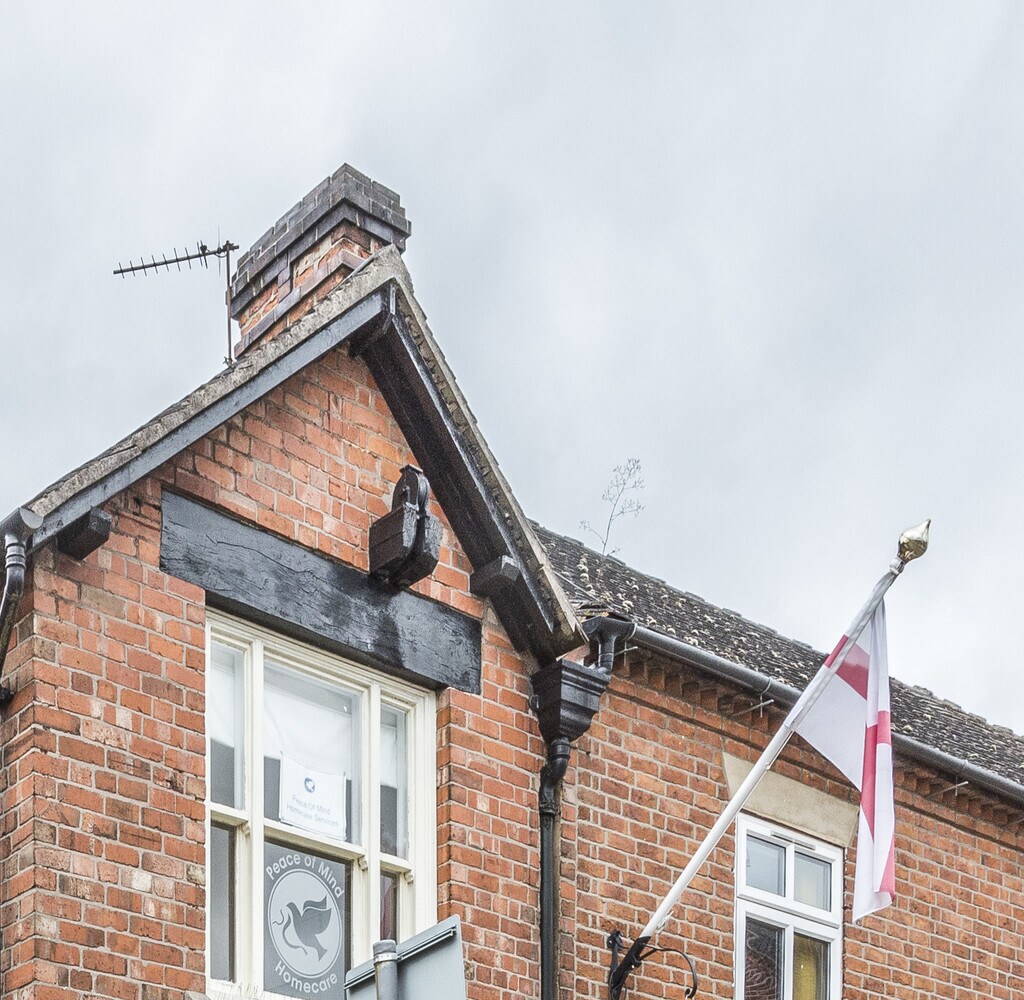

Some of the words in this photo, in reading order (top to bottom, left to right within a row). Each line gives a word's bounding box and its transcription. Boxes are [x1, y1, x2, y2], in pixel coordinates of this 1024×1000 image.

[265, 853, 301, 881] Peace
[304, 856, 316, 868] of
[318, 861, 345, 898] Mind
[275, 960, 338, 994] Homecare
